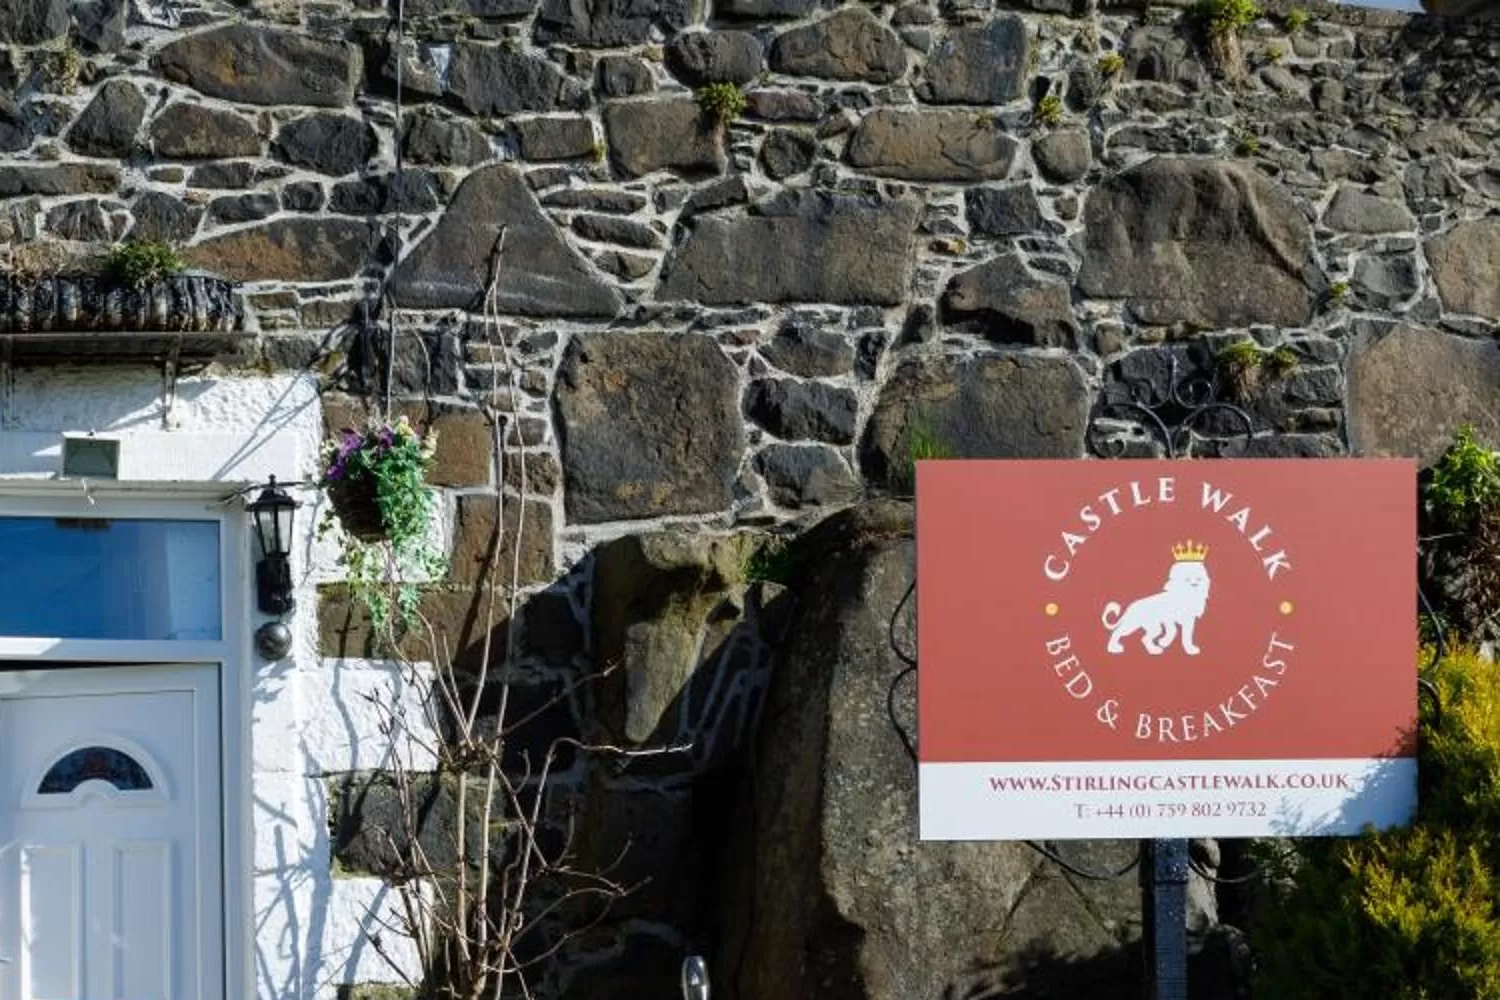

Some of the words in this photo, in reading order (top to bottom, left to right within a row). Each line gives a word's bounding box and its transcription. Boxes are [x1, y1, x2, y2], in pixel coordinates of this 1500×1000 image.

[1044, 476, 1176, 580] CASTLE
[1201, 481, 1291, 582] WALK
[1045, 632, 1093, 700] BED
[1096, 699, 1119, 729] &
[1135, 632, 1295, 742] BREAKFAST
[1096, 803, 1125, 818] +44
[1129, 802, 1151, 819] (0)
[1156, 802, 1186, 818] 759
[1191, 801, 1221, 817] 802
[1226, 801, 1267, 817] 9732
